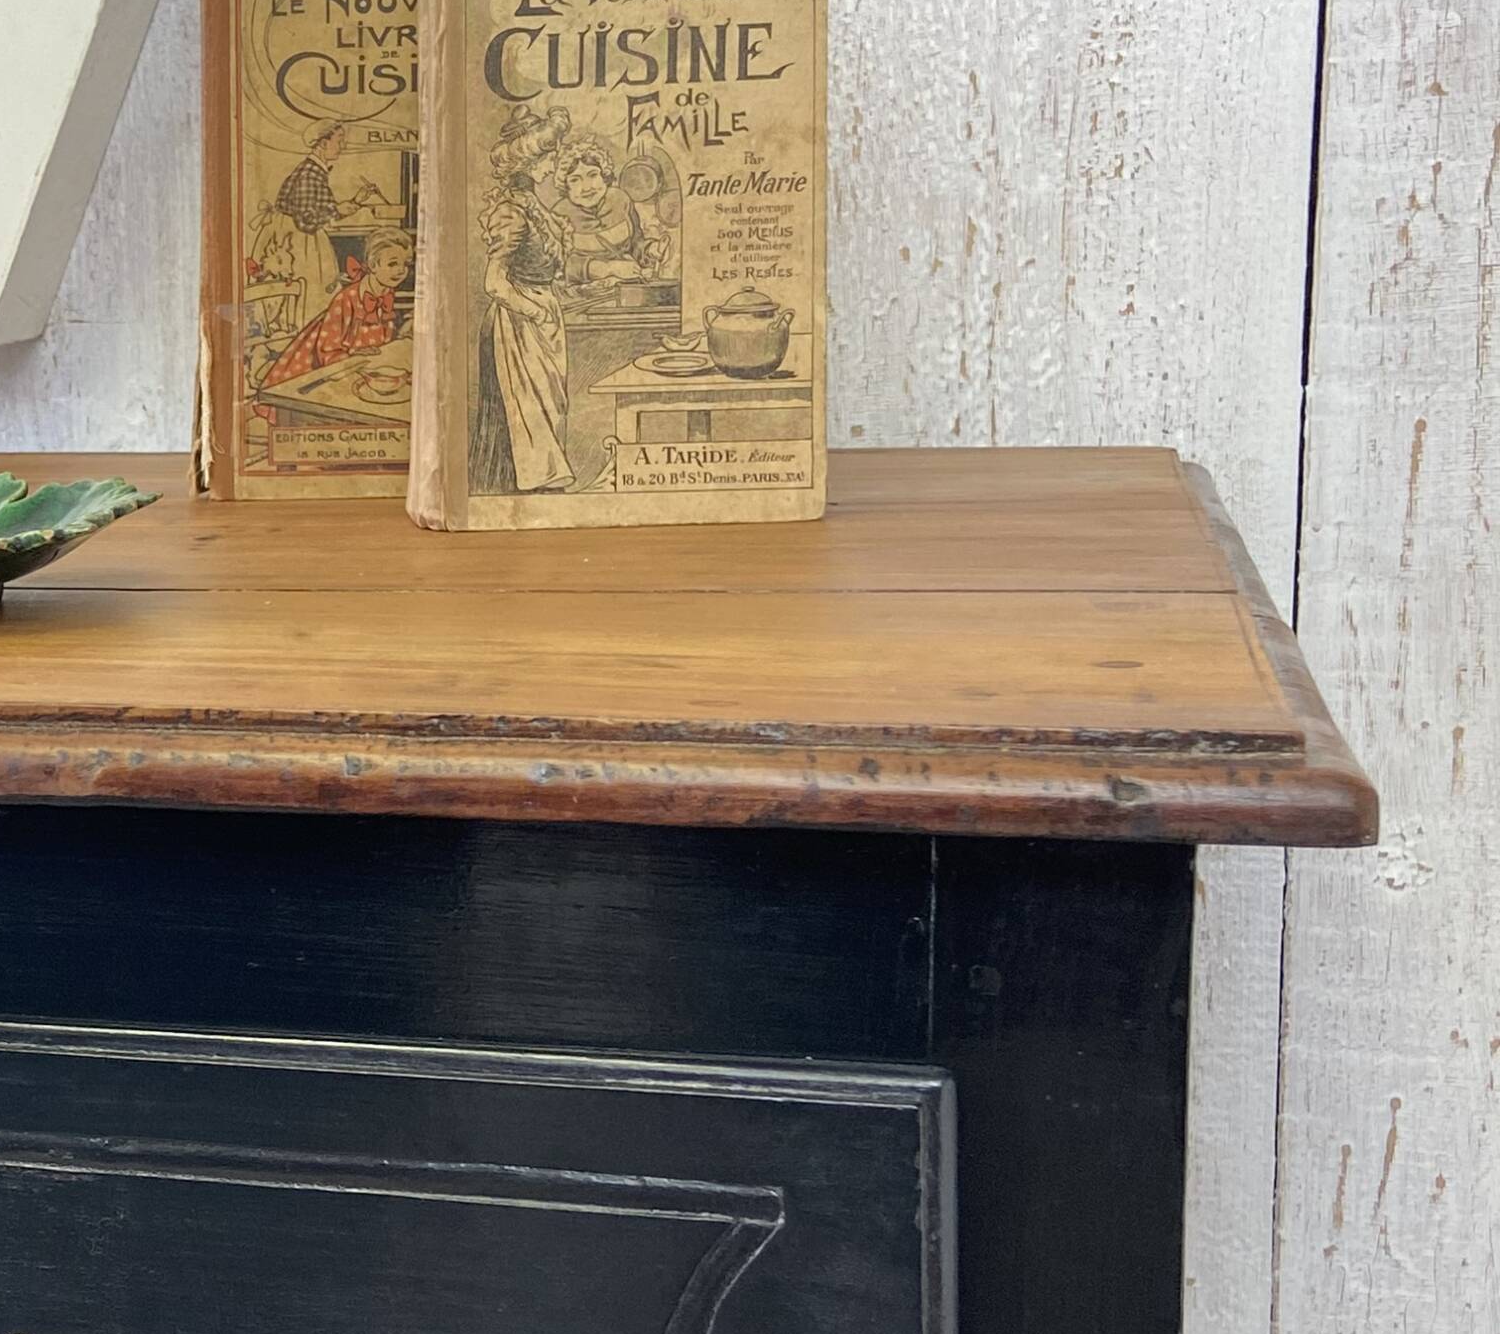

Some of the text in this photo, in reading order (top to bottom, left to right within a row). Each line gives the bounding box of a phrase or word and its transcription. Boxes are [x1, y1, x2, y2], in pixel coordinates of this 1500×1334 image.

[380, 50, 400, 59] DE
[484, 17, 795, 102] CUISINE
[675, 88, 710, 108] de
[626, 93, 749, 153] FAMILLE
[744, 151, 765, 165] Par
[687, 168, 807, 197] Tante Marie
[714, 203, 795, 216] Seul ouvrage
[730, 215, 780, 226] contenant
[717, 229, 743, 239] 500
[710, 243, 721, 252] et
[728, 241, 738, 252] la
[275, 429, 411, 443] EDITIONS GAUTIER-
[317, 450, 341, 458] RUE
[622, 474, 634, 486] 18
[649, 473, 666, 485] 20
